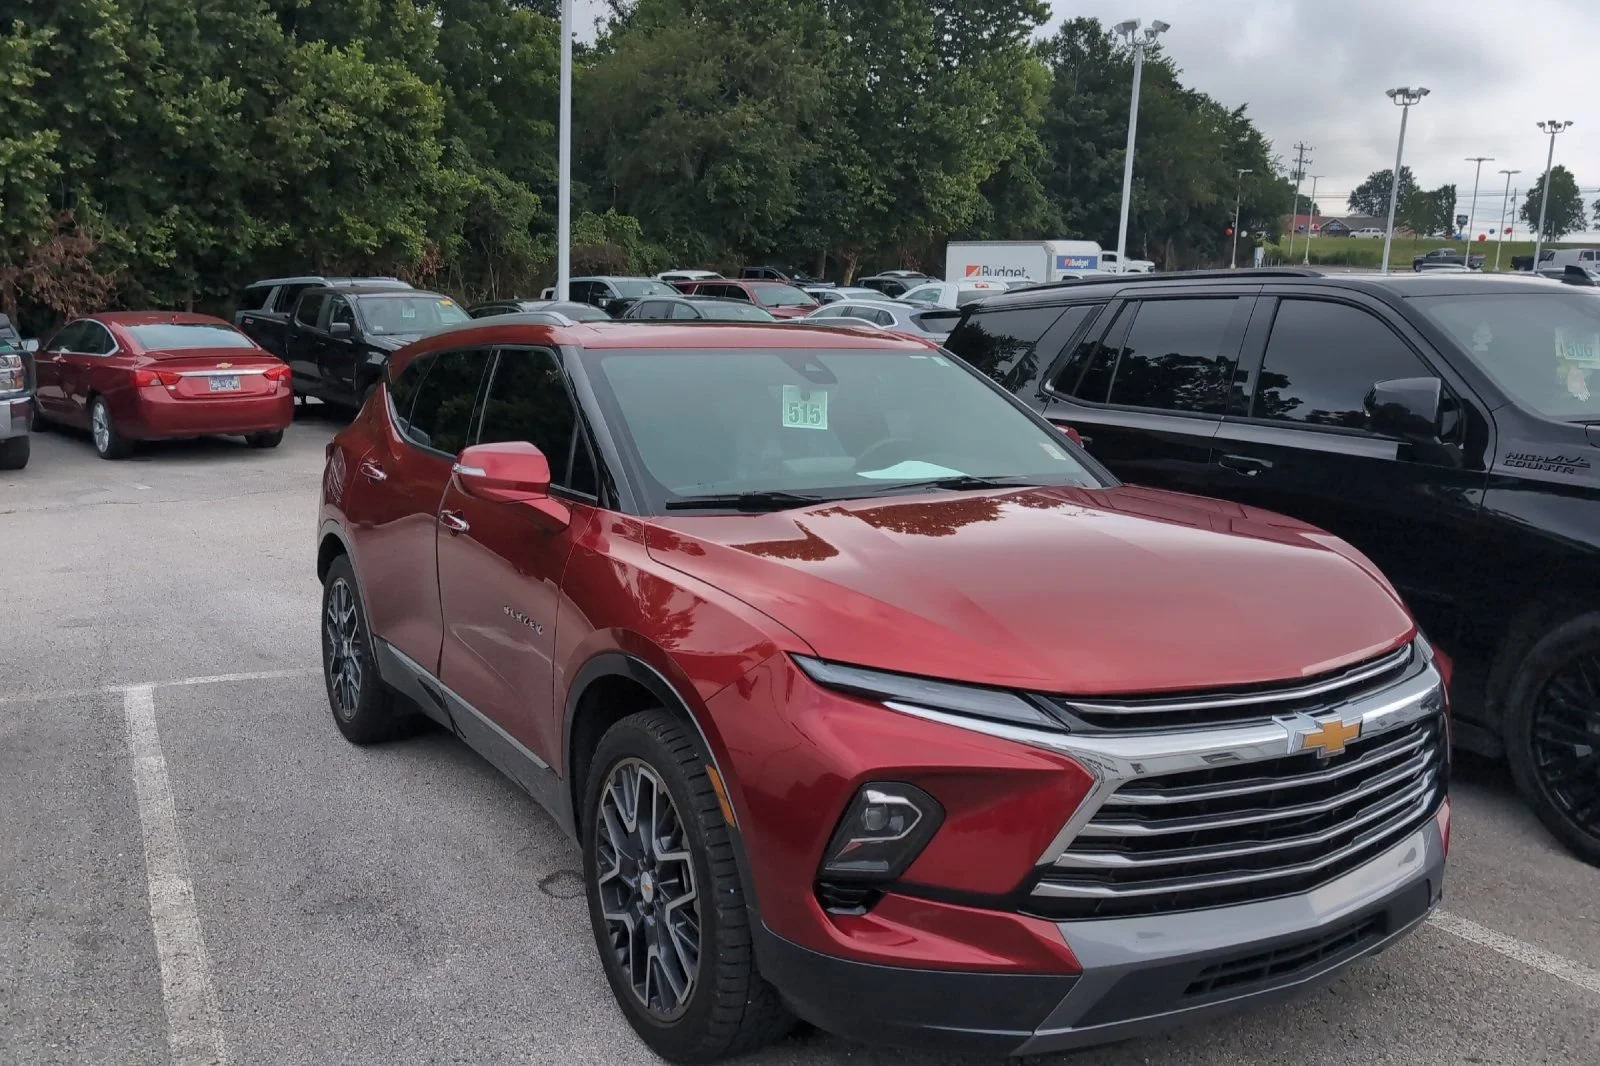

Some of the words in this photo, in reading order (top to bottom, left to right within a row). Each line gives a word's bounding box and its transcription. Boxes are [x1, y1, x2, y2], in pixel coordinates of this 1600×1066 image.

[1071, 258, 1089, 269] Budget
[982, 264, 1026, 278] Budget
[789, 402, 821, 425] 515
